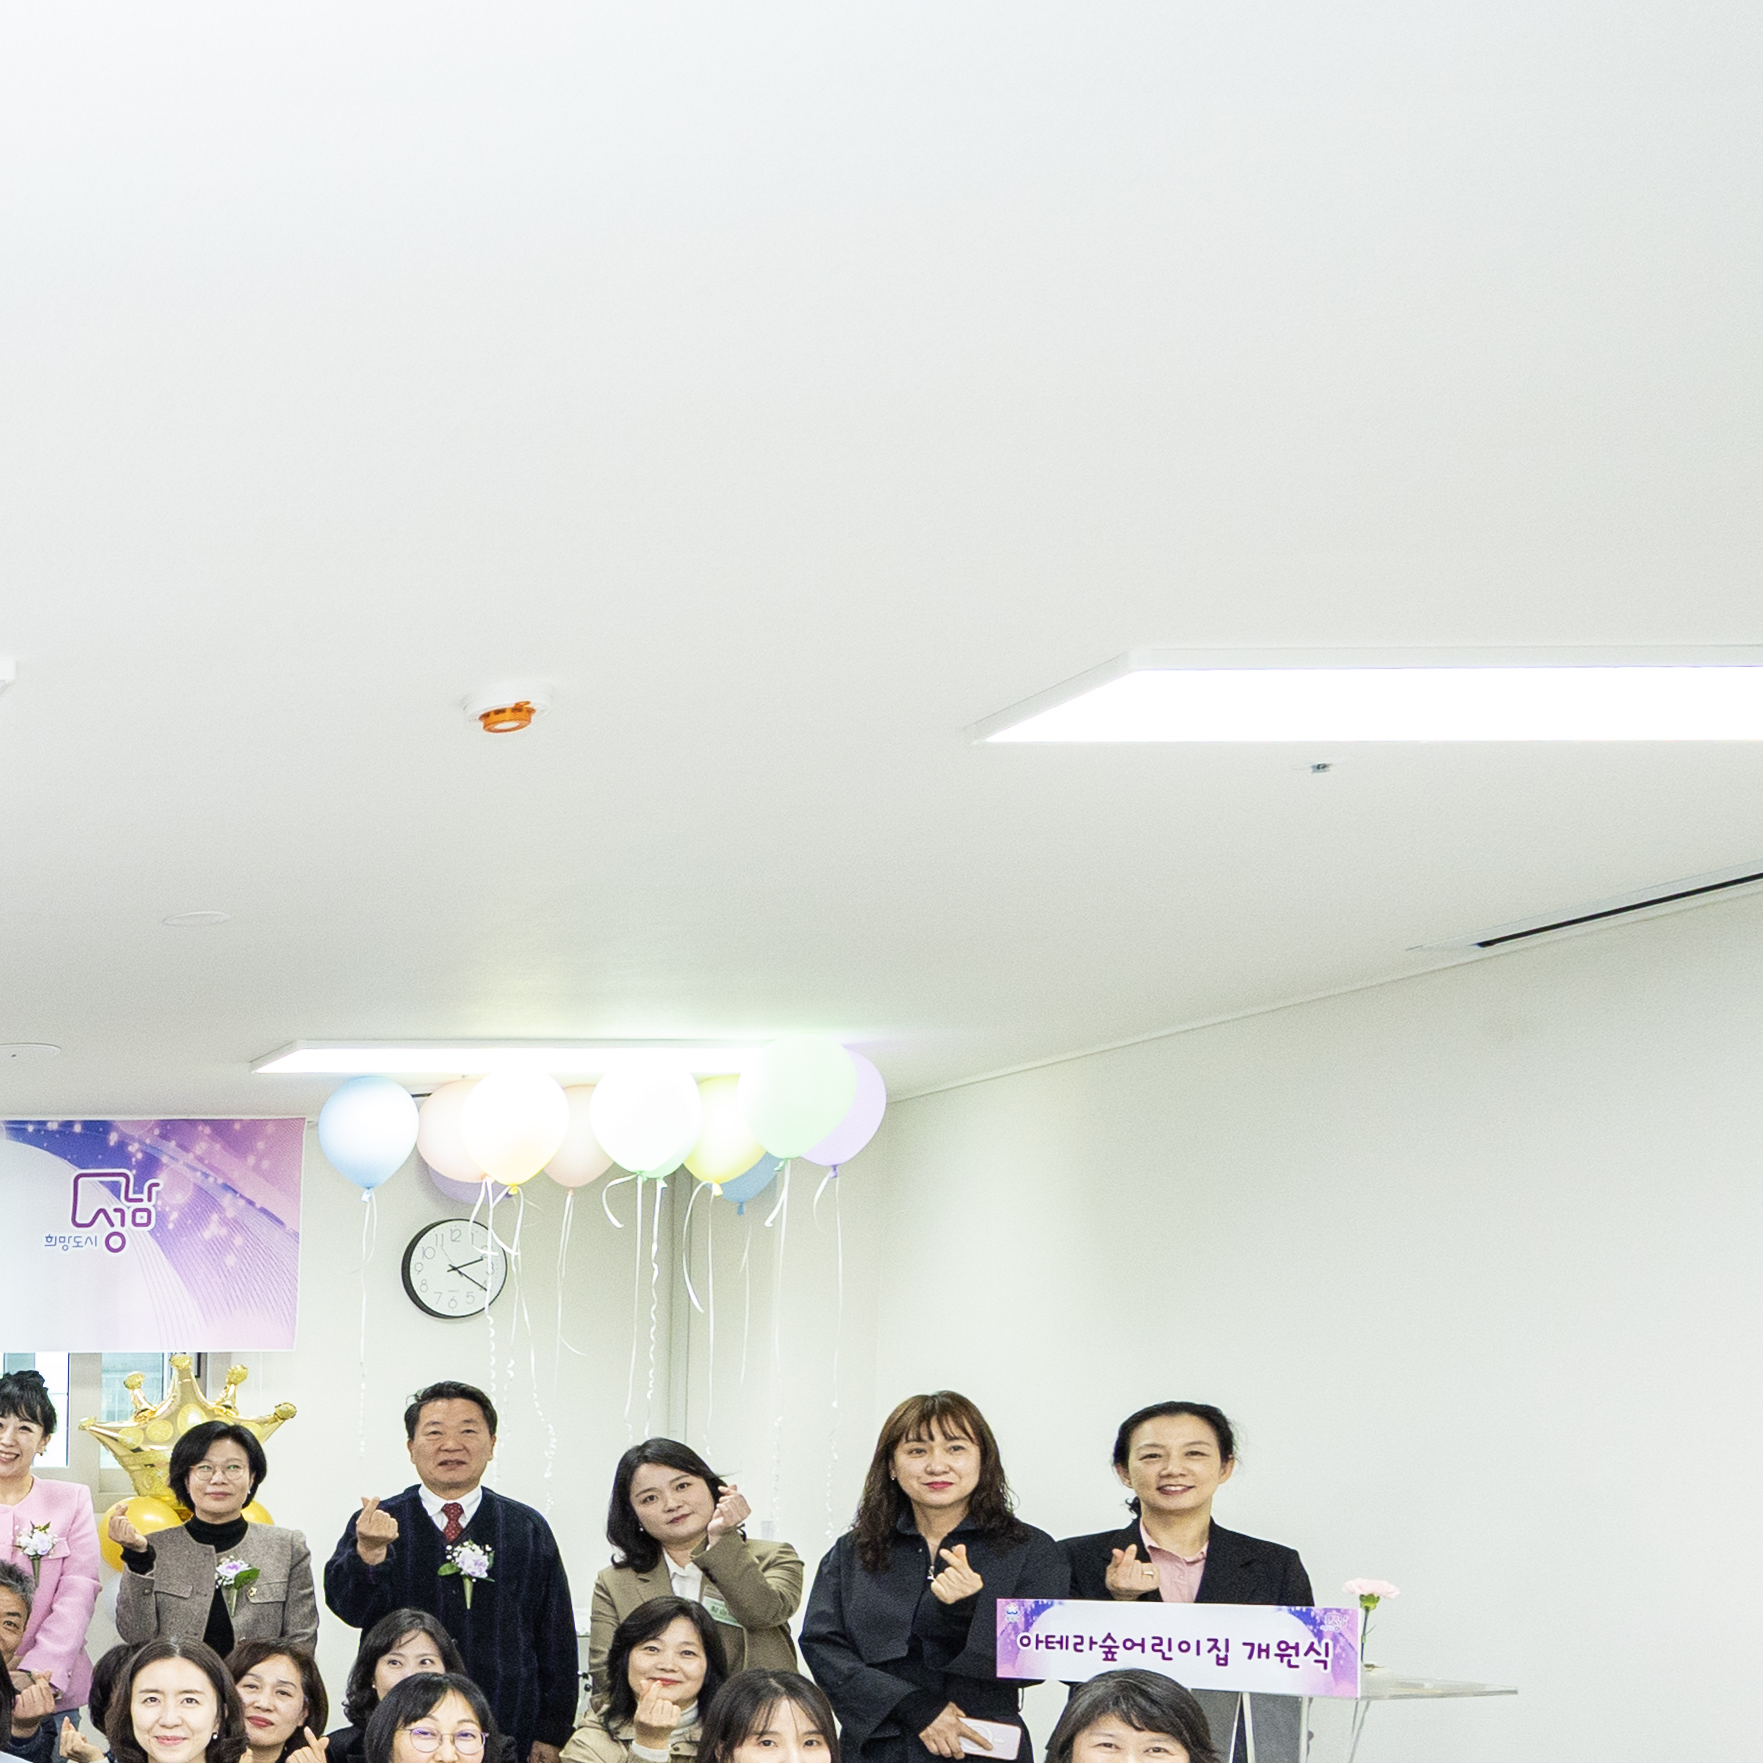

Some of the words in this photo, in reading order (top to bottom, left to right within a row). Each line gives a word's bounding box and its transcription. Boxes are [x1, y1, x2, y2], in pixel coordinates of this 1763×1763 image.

[43, 1233, 98, 1253] 희망도시
[434, 1233, 445, 1248] 11
[449, 1228, 462, 1243] 12
[421, 1246, 436, 1260] 10
[414, 1261, 424, 1275] 9
[419, 1278, 429, 1293] 8
[433, 1291, 443, 1305] 7
[447, 1295, 458, 1310] 6
[465, 1290, 476, 1305] 5
[1018, 1632, 1230, 1667] 아테라숲어린이집
[1241, 1640, 1331, 1670] 개원식
